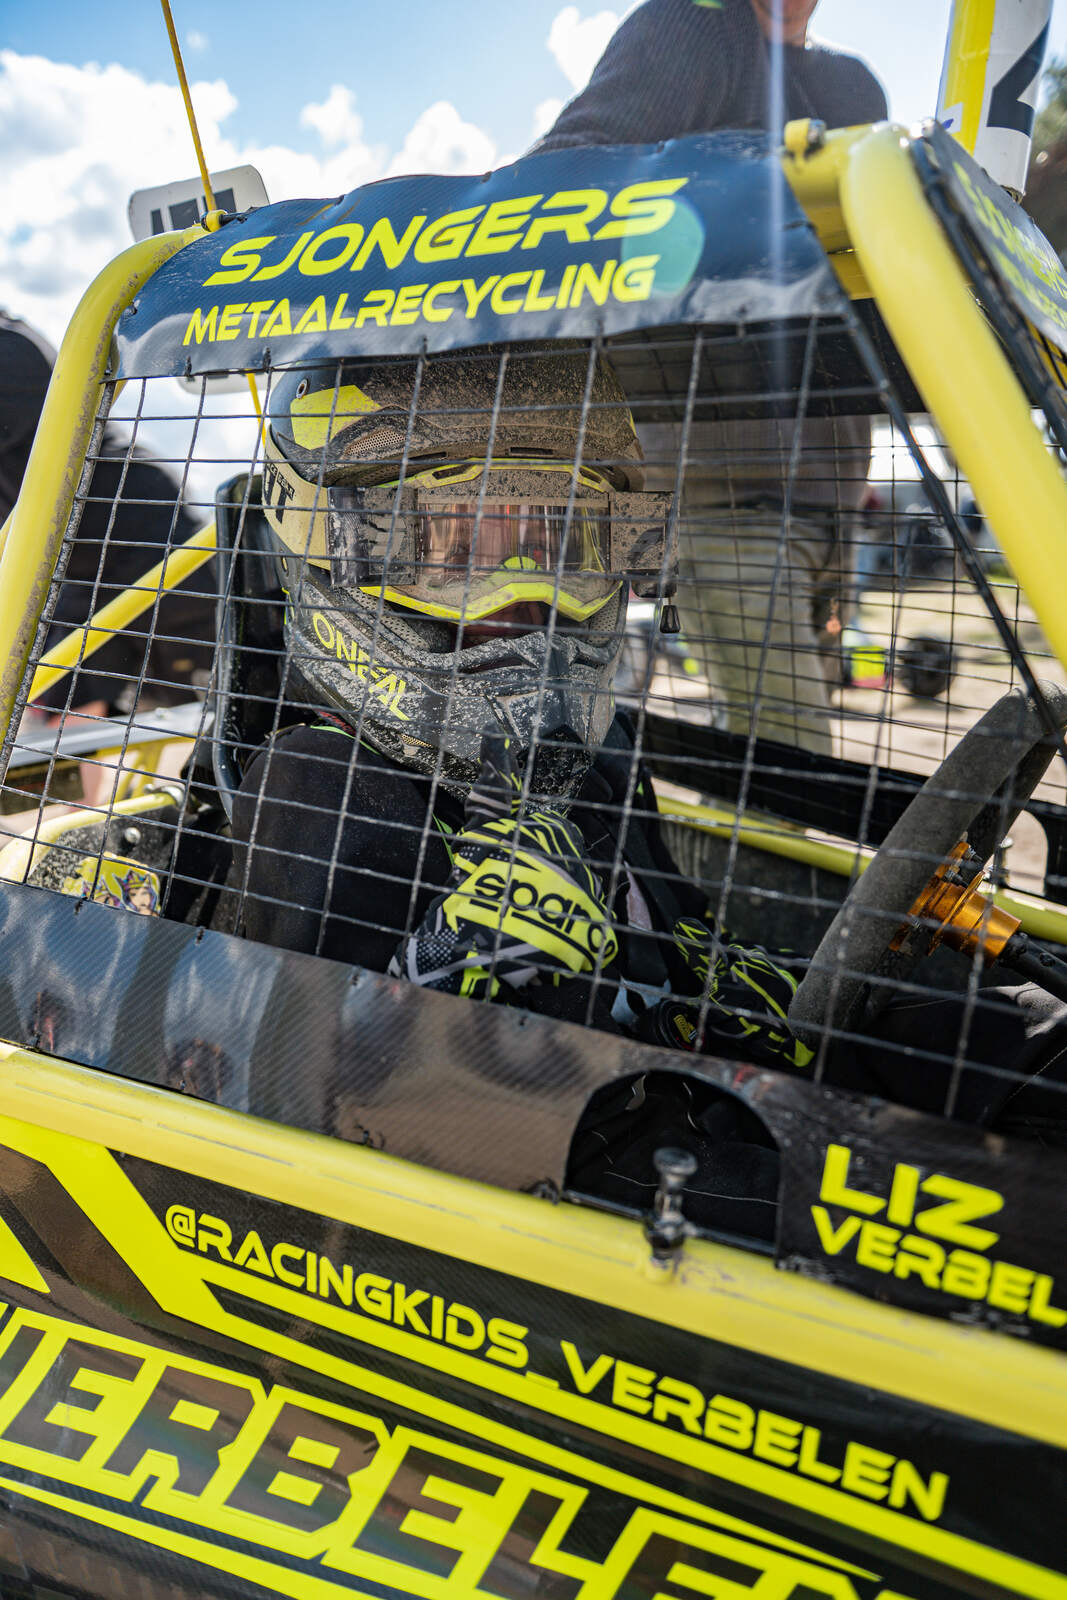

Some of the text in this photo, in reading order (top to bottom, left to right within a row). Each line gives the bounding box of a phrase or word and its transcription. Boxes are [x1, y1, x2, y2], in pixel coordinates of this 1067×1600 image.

[203, 177, 689, 287] SJONGERS
[182, 253, 661, 346] METAALRECYCLING
[819, 1143, 1004, 1250] LIZ
[810, 1205, 1067, 1328] VERBEL
[165, 1204, 950, 1521] @RACINGKIDS_VERBELEN
